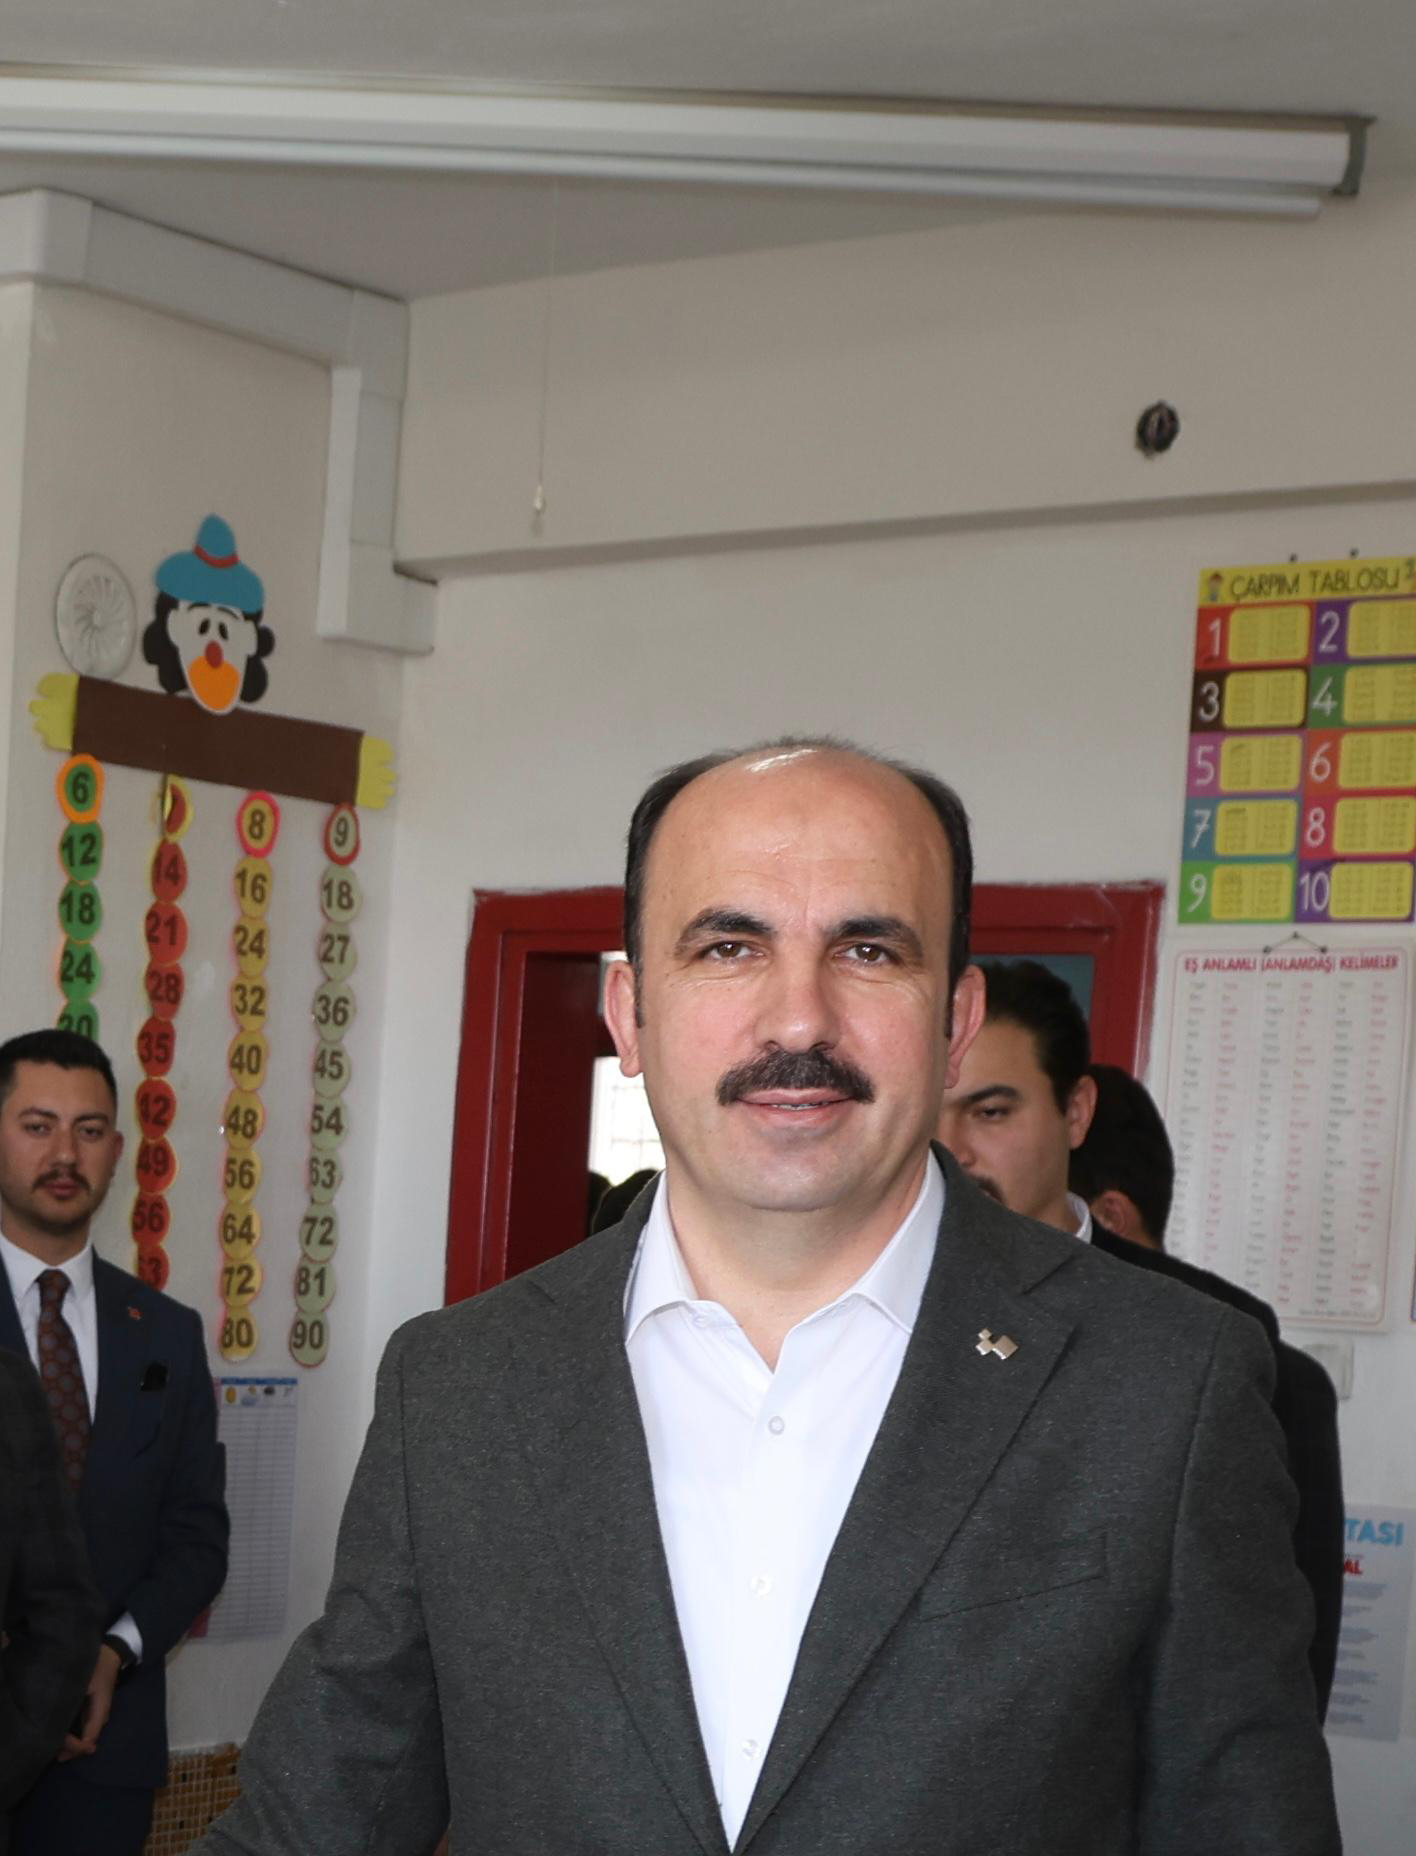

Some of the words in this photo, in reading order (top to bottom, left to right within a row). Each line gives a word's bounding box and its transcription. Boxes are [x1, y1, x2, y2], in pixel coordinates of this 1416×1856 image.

[1231, 573, 1300, 602] ÇARPIM
[1309, 567, 1400, 593] TABLOSU
[1208, 618, 1221, 657] 1
[1319, 611, 1340, 653] 2
[1199, 682, 1220, 722] 3
[1313, 677, 1336, 716] 4
[1195, 745, 1215, 786] 5
[1309, 743, 1331, 783] 6
[73, 772, 89, 804] 6
[249, 809, 266, 840] 8
[334, 816, 349, 847] 9
[1191, 809, 1211, 848] 7
[1307, 807, 1325, 847] 8
[61, 833, 97, 867] 12
[152, 853, 180, 886] 14
[235, 872, 267, 904] 16
[323, 878, 354, 910] 18
[1188, 873, 1207, 912] 9
[1299, 872, 1330, 912] 10
[59, 891, 95, 925] 18
[145, 916, 178, 945] 21
[234, 926, 265, 958] 24
[321, 934, 350, 963] 27
[1184, 958, 1198, 974] EŞ
[1203, 957, 1257, 971] ANLAMLI
[1339, 955, 1399, 970] KELİMELER
[61, 950, 95, 984] 24
[148, 970, 180, 1009] 28
[234, 984, 266, 1016] 32
[317, 995, 349, 1027] 36
[139, 1033, 170, 1063] 35
[230, 1044, 261, 1075] 40
[314, 1050, 344, 1080] 45
[137, 1095, 169, 1127] 42
[227, 1105, 258, 1139] 48
[311, 1104, 343, 1136] 54
[136, 1146, 169, 1175] 49
[225, 1158, 255, 1189] 56
[309, 1157, 336, 1189] 63
[134, 1204, 165, 1232] 56
[223, 1214, 255, 1244] 64
[304, 1216, 334, 1246] 72
[224, 1265, 255, 1295] 72
[297, 1272, 327, 1303] 81
[221, 1317, 254, 1348] 80
[291, 1319, 324, 1349] 90
[1344, 1517, 1404, 1548] TASI
